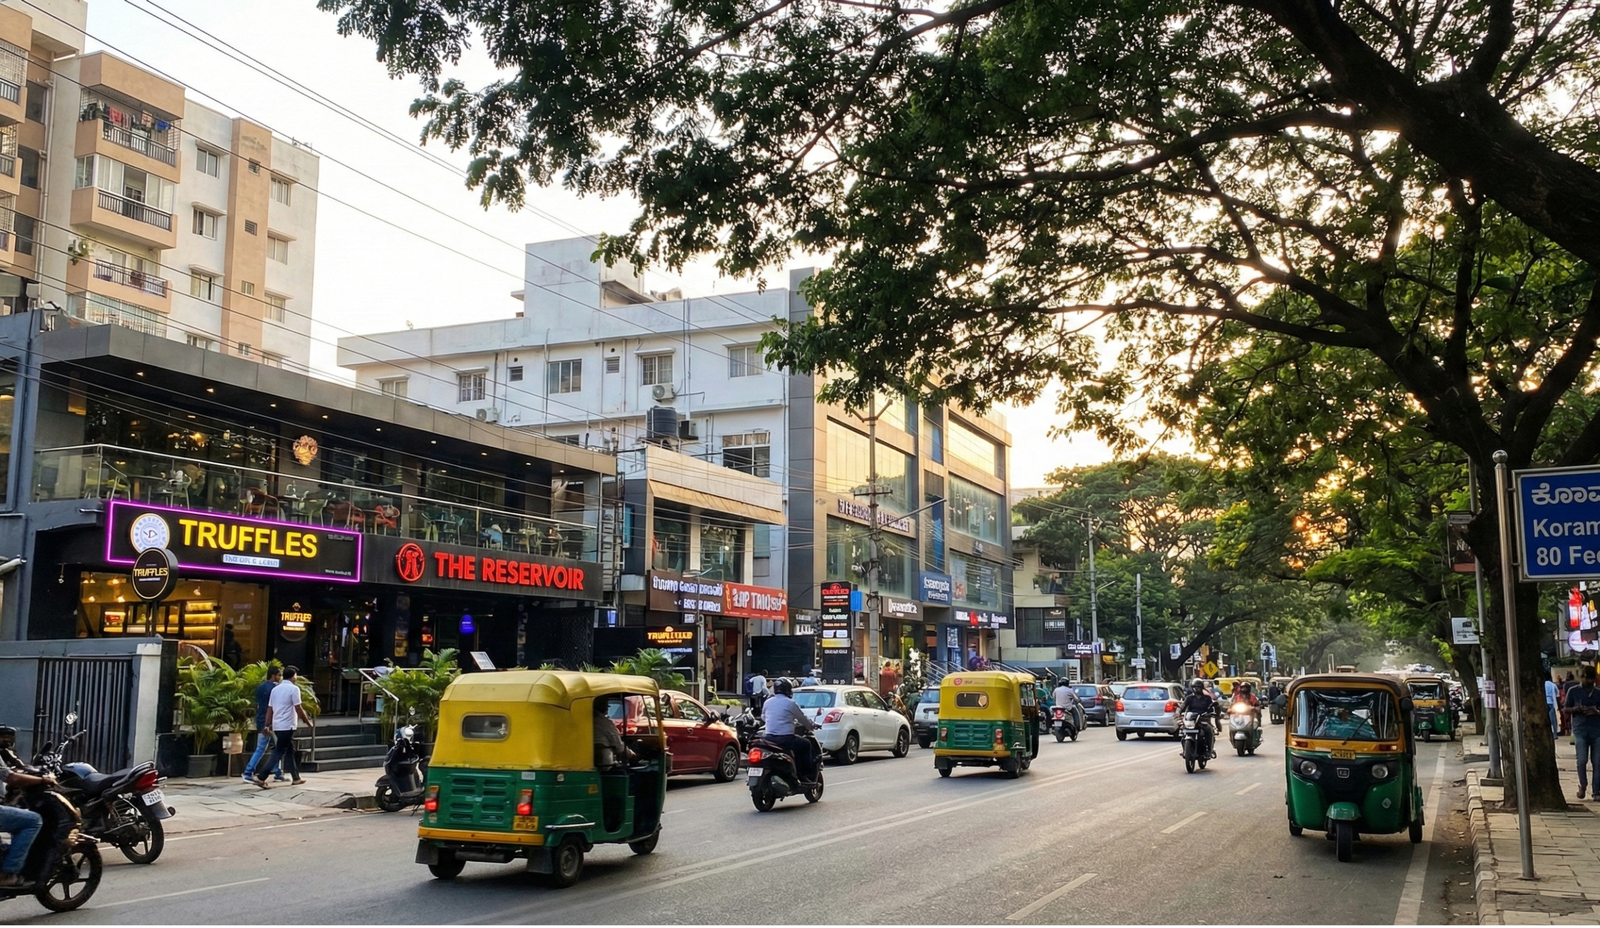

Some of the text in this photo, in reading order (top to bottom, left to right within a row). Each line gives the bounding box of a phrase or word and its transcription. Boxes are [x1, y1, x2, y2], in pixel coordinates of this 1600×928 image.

[179, 518, 318, 558] TRUFFLES
[434, 551, 585, 590] THE RESERVOIR
[1536, 545, 1600, 566] 80 Fe
[133, 567, 169, 577] TRUFFLES
